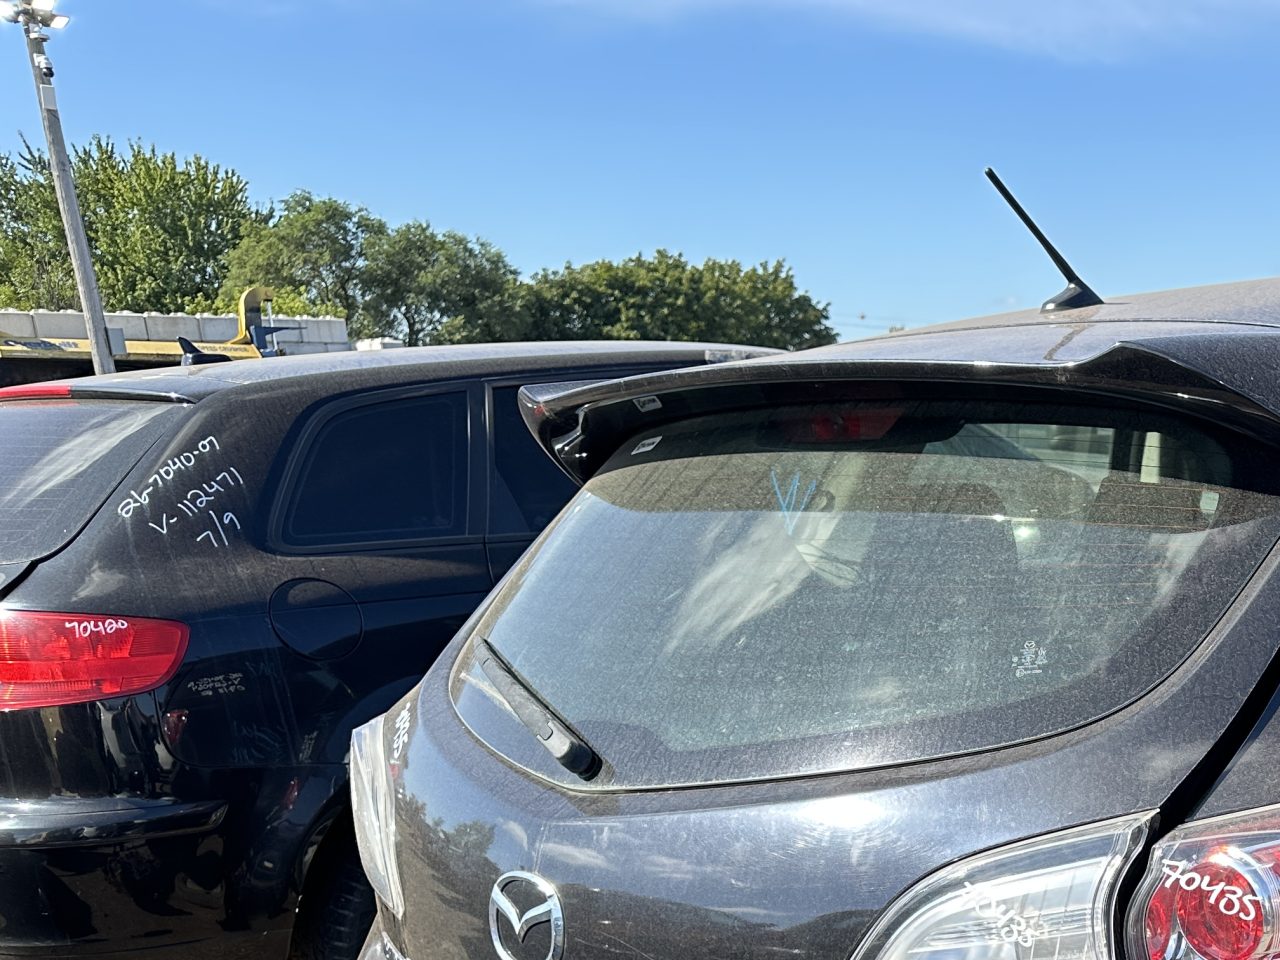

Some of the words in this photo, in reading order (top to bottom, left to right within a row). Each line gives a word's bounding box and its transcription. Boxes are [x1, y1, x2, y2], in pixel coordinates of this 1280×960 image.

[148, 466, 244, 534] V-112471
[196, 510, 241, 548] 7/9
[64, 618, 128, 638] 70420
[1161, 857, 1263, 922] 70435
